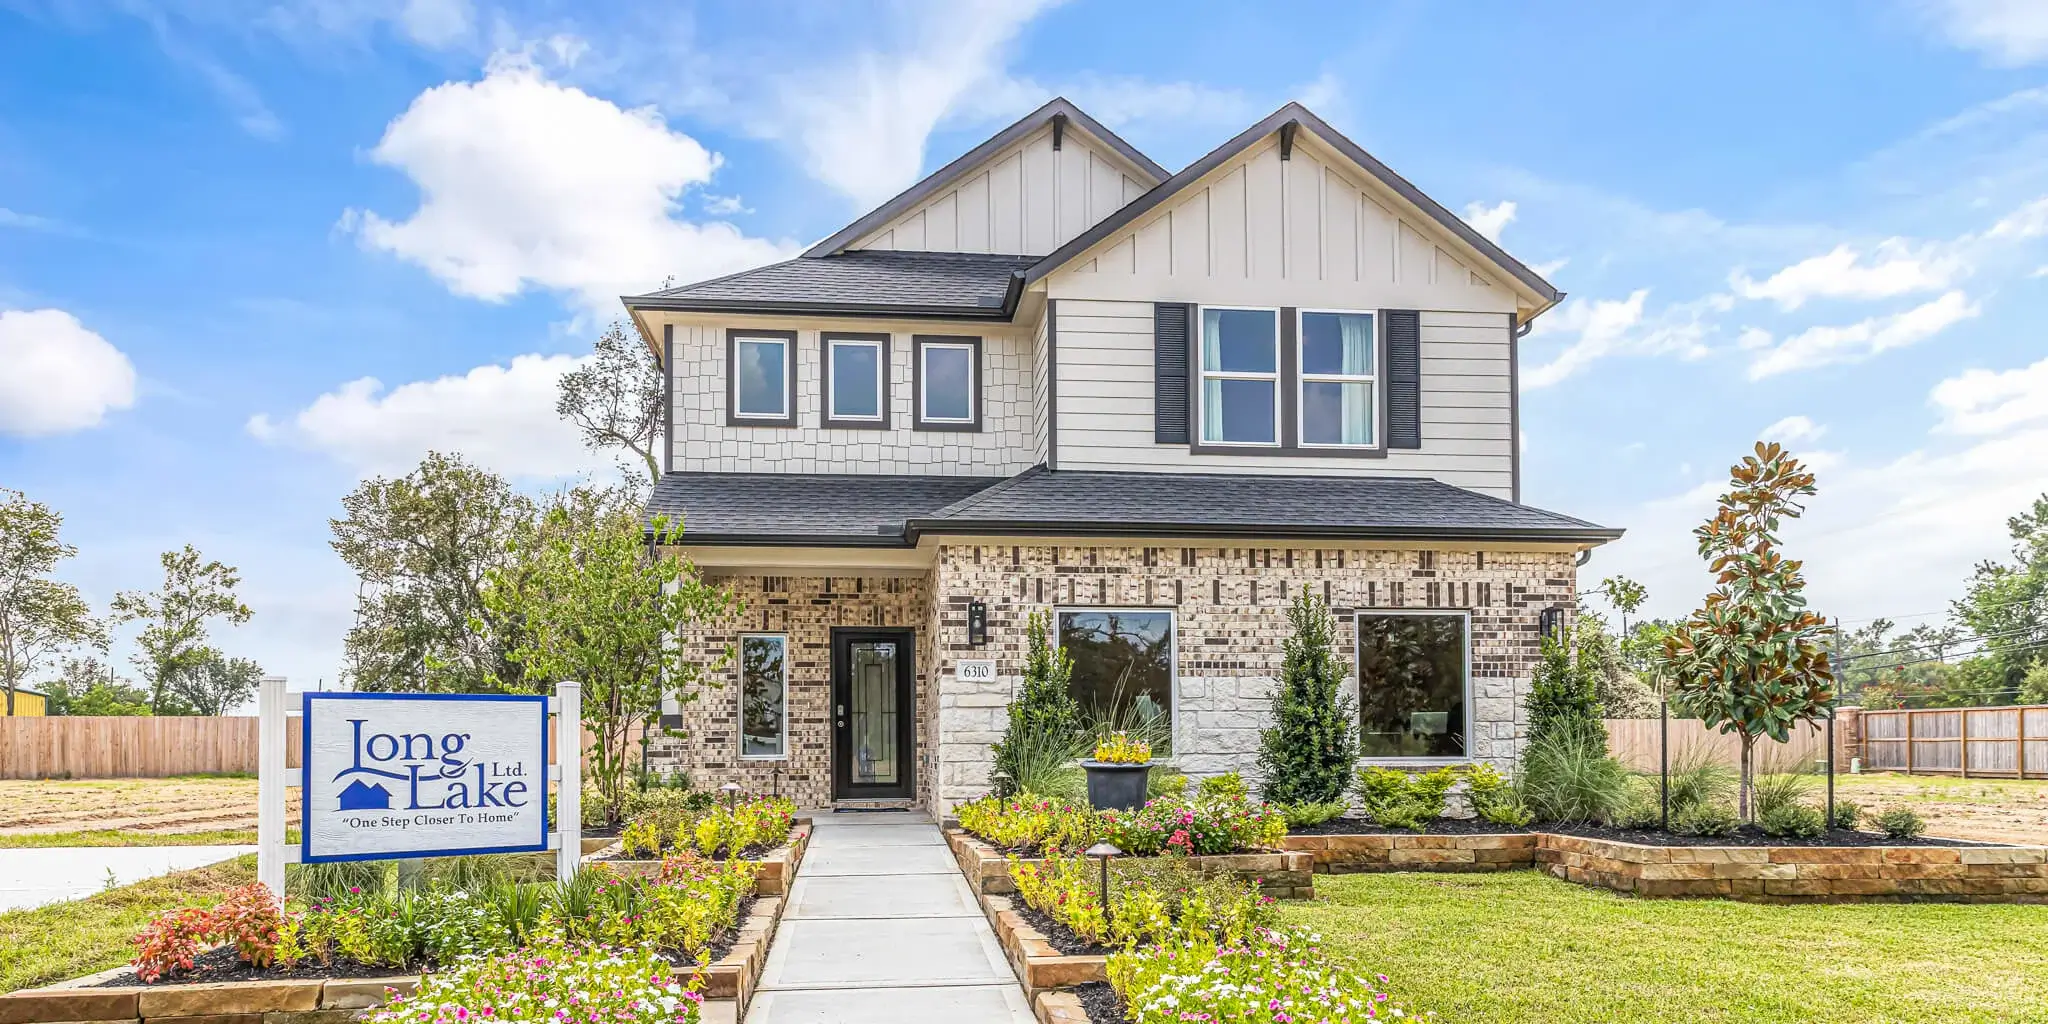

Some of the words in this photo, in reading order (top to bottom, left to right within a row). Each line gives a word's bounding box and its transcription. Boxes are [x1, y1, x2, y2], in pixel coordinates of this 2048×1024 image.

[964, 665, 989, 678] 6310
[332, 719, 473, 779] Long
[493, 762, 528, 777] Ltd.
[403, 763, 528, 810] Lake
[381, 816, 410, 830] Step
[414, 814, 454, 826] Closer
[457, 813, 474, 824] To
